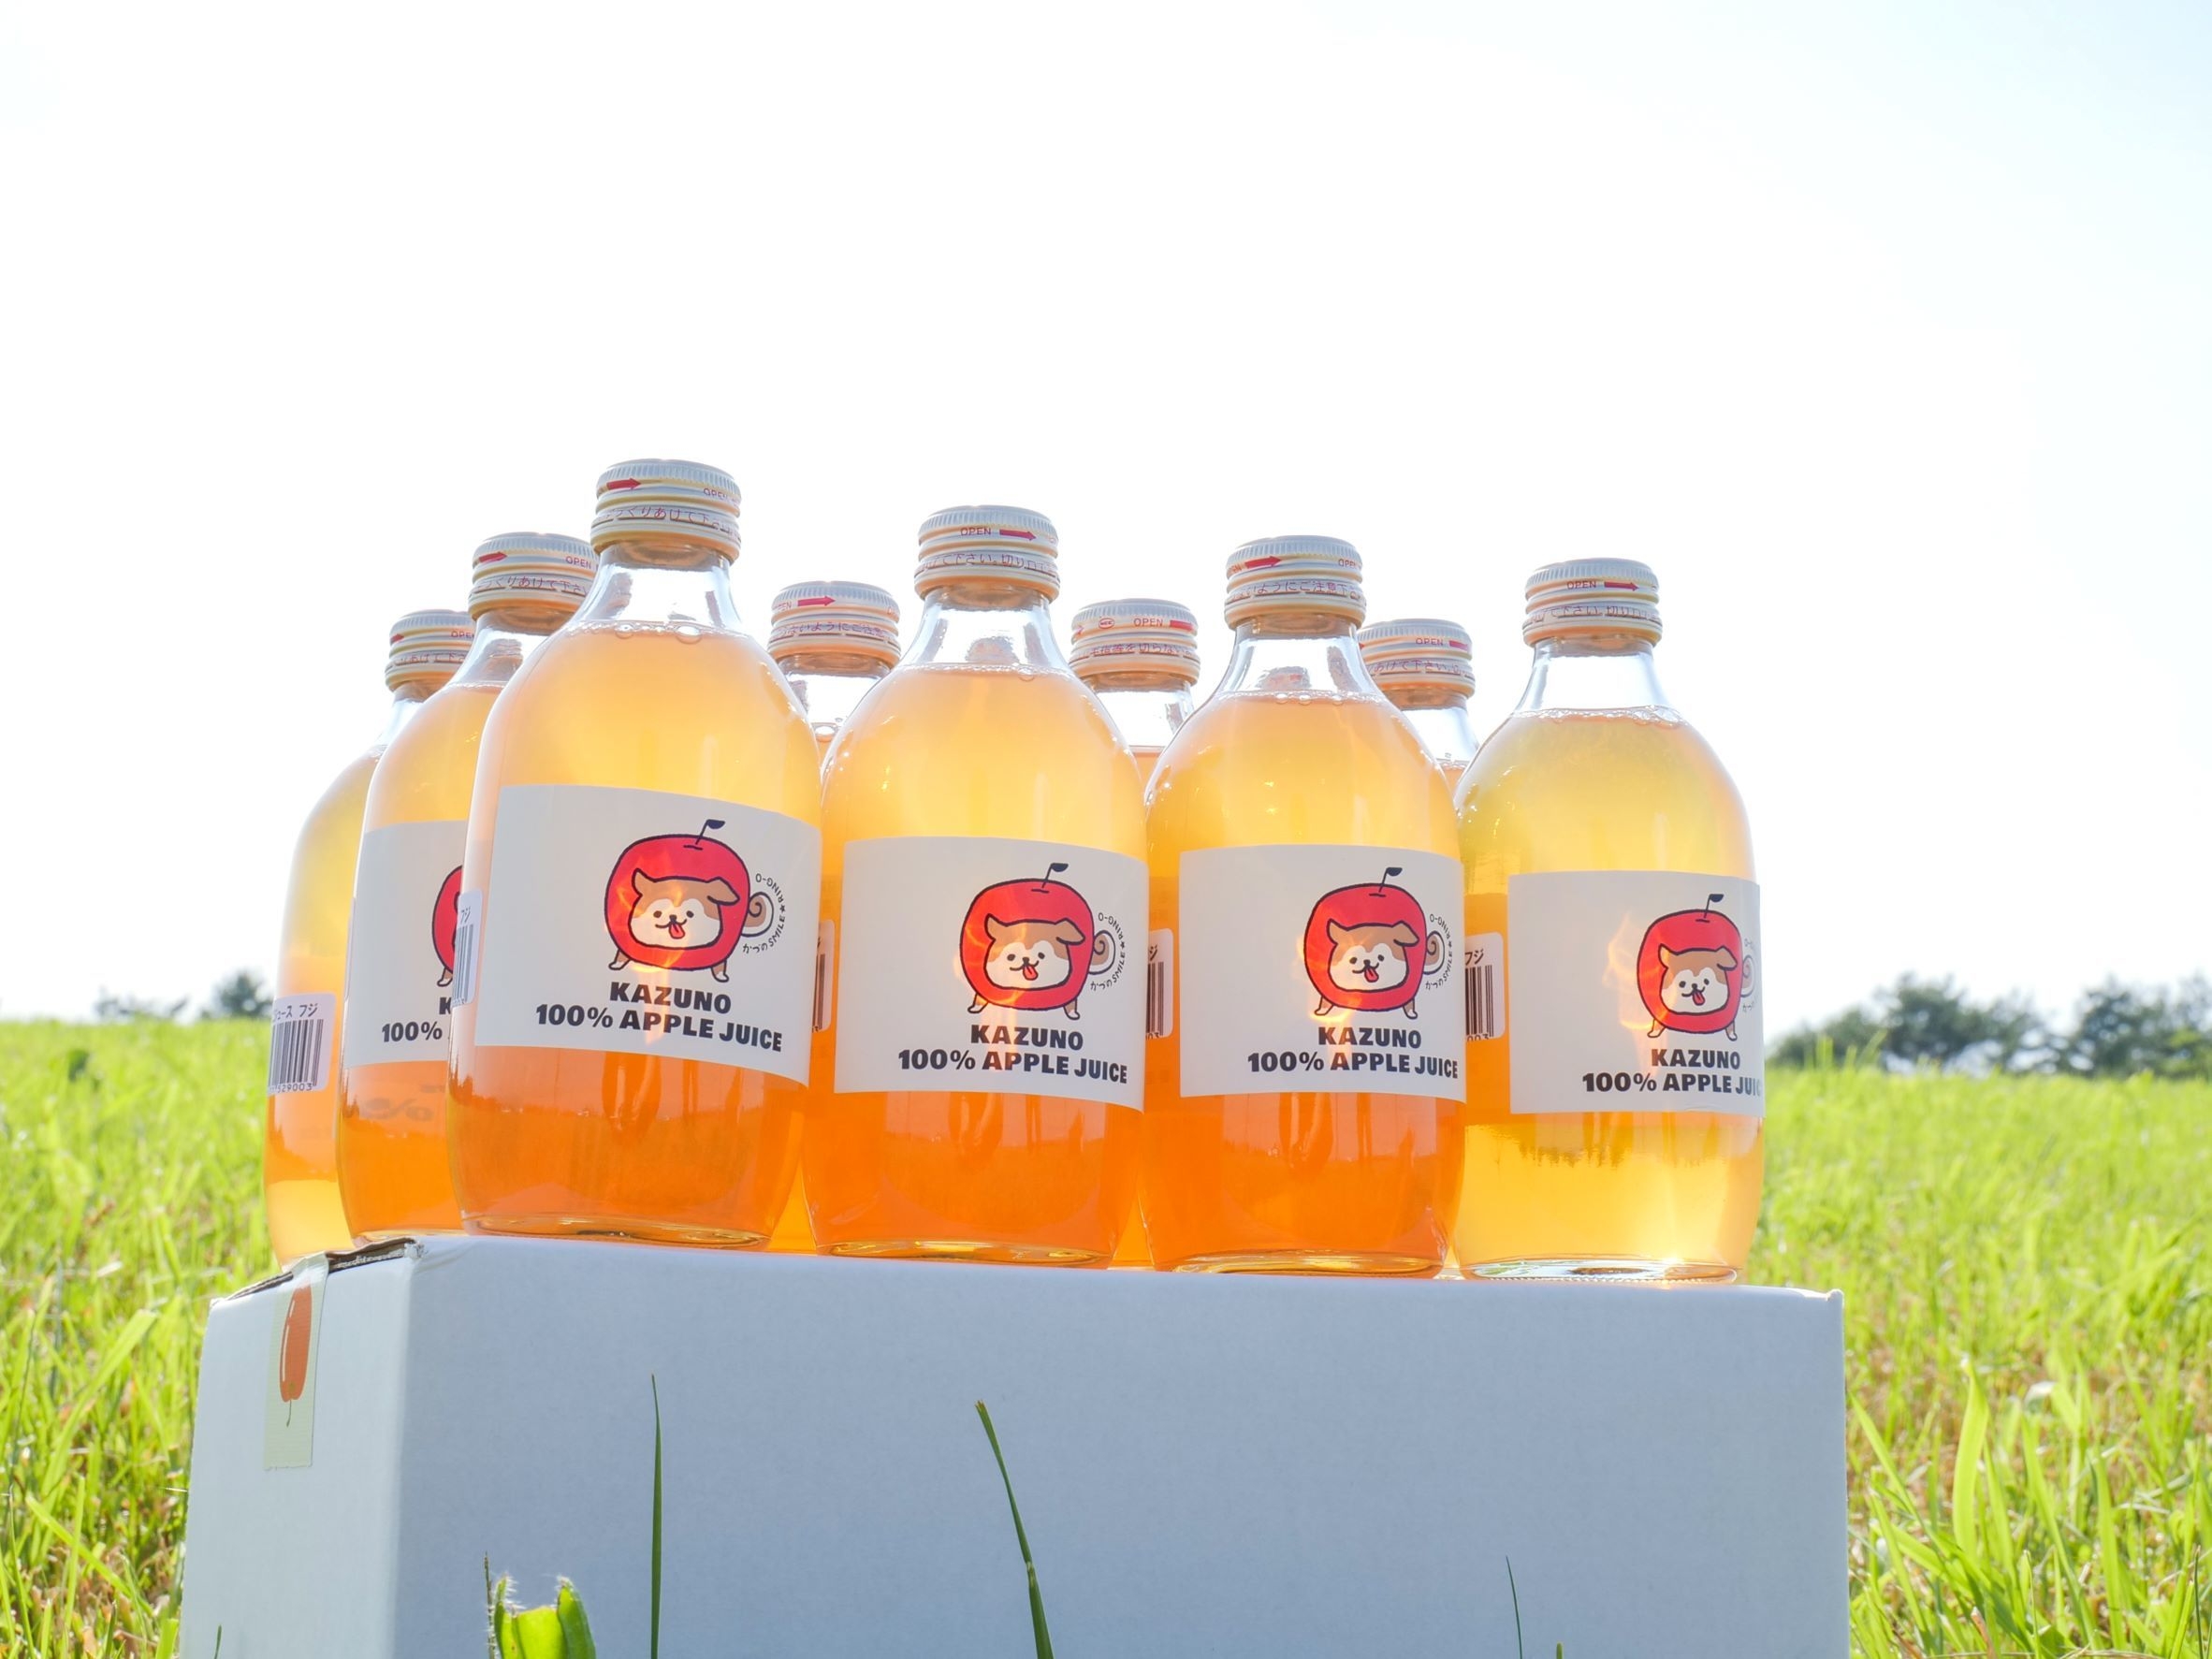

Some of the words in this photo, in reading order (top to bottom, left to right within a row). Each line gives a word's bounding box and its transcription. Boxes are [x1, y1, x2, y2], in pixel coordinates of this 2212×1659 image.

[960, 527, 992, 536] OPEN
[565, 556, 591, 570] OPEN
[1566, 580, 1596, 589] OPEN
[1132, 618, 1164, 627] OPEN
[1415, 637, 1444, 647] OPEN
[1465, 948, 1484, 966] フジ
[609, 982, 732, 1014] KAZUNO
[298, 1002, 318, 1018] フジ
[381, 1021, 444, 1042] 100%
[535, 1003, 614, 1028] 100%
[619, 1009, 715, 1039] APPLE
[719, 1022, 782, 1053] JUICE
[970, 1024, 1084, 1051] KAZUNO
[1317, 1026, 1421, 1049] KAZUNO
[898, 1048, 976, 1070] 100%
[982, 1051, 1070, 1075] APPLE
[1073, 1057, 1128, 1084] JUICE
[1247, 1051, 1324, 1072] 100%
[1330, 1052, 1410, 1073] APPLE
[1414, 1055, 1458, 1079] JUICE
[1651, 1048, 1741, 1070] KAZUNO
[1582, 1071, 1657, 1092] 100%
[1662, 1073, 1732, 1094] APPLE
[1736, 1076, 1762, 1097] JUIC
